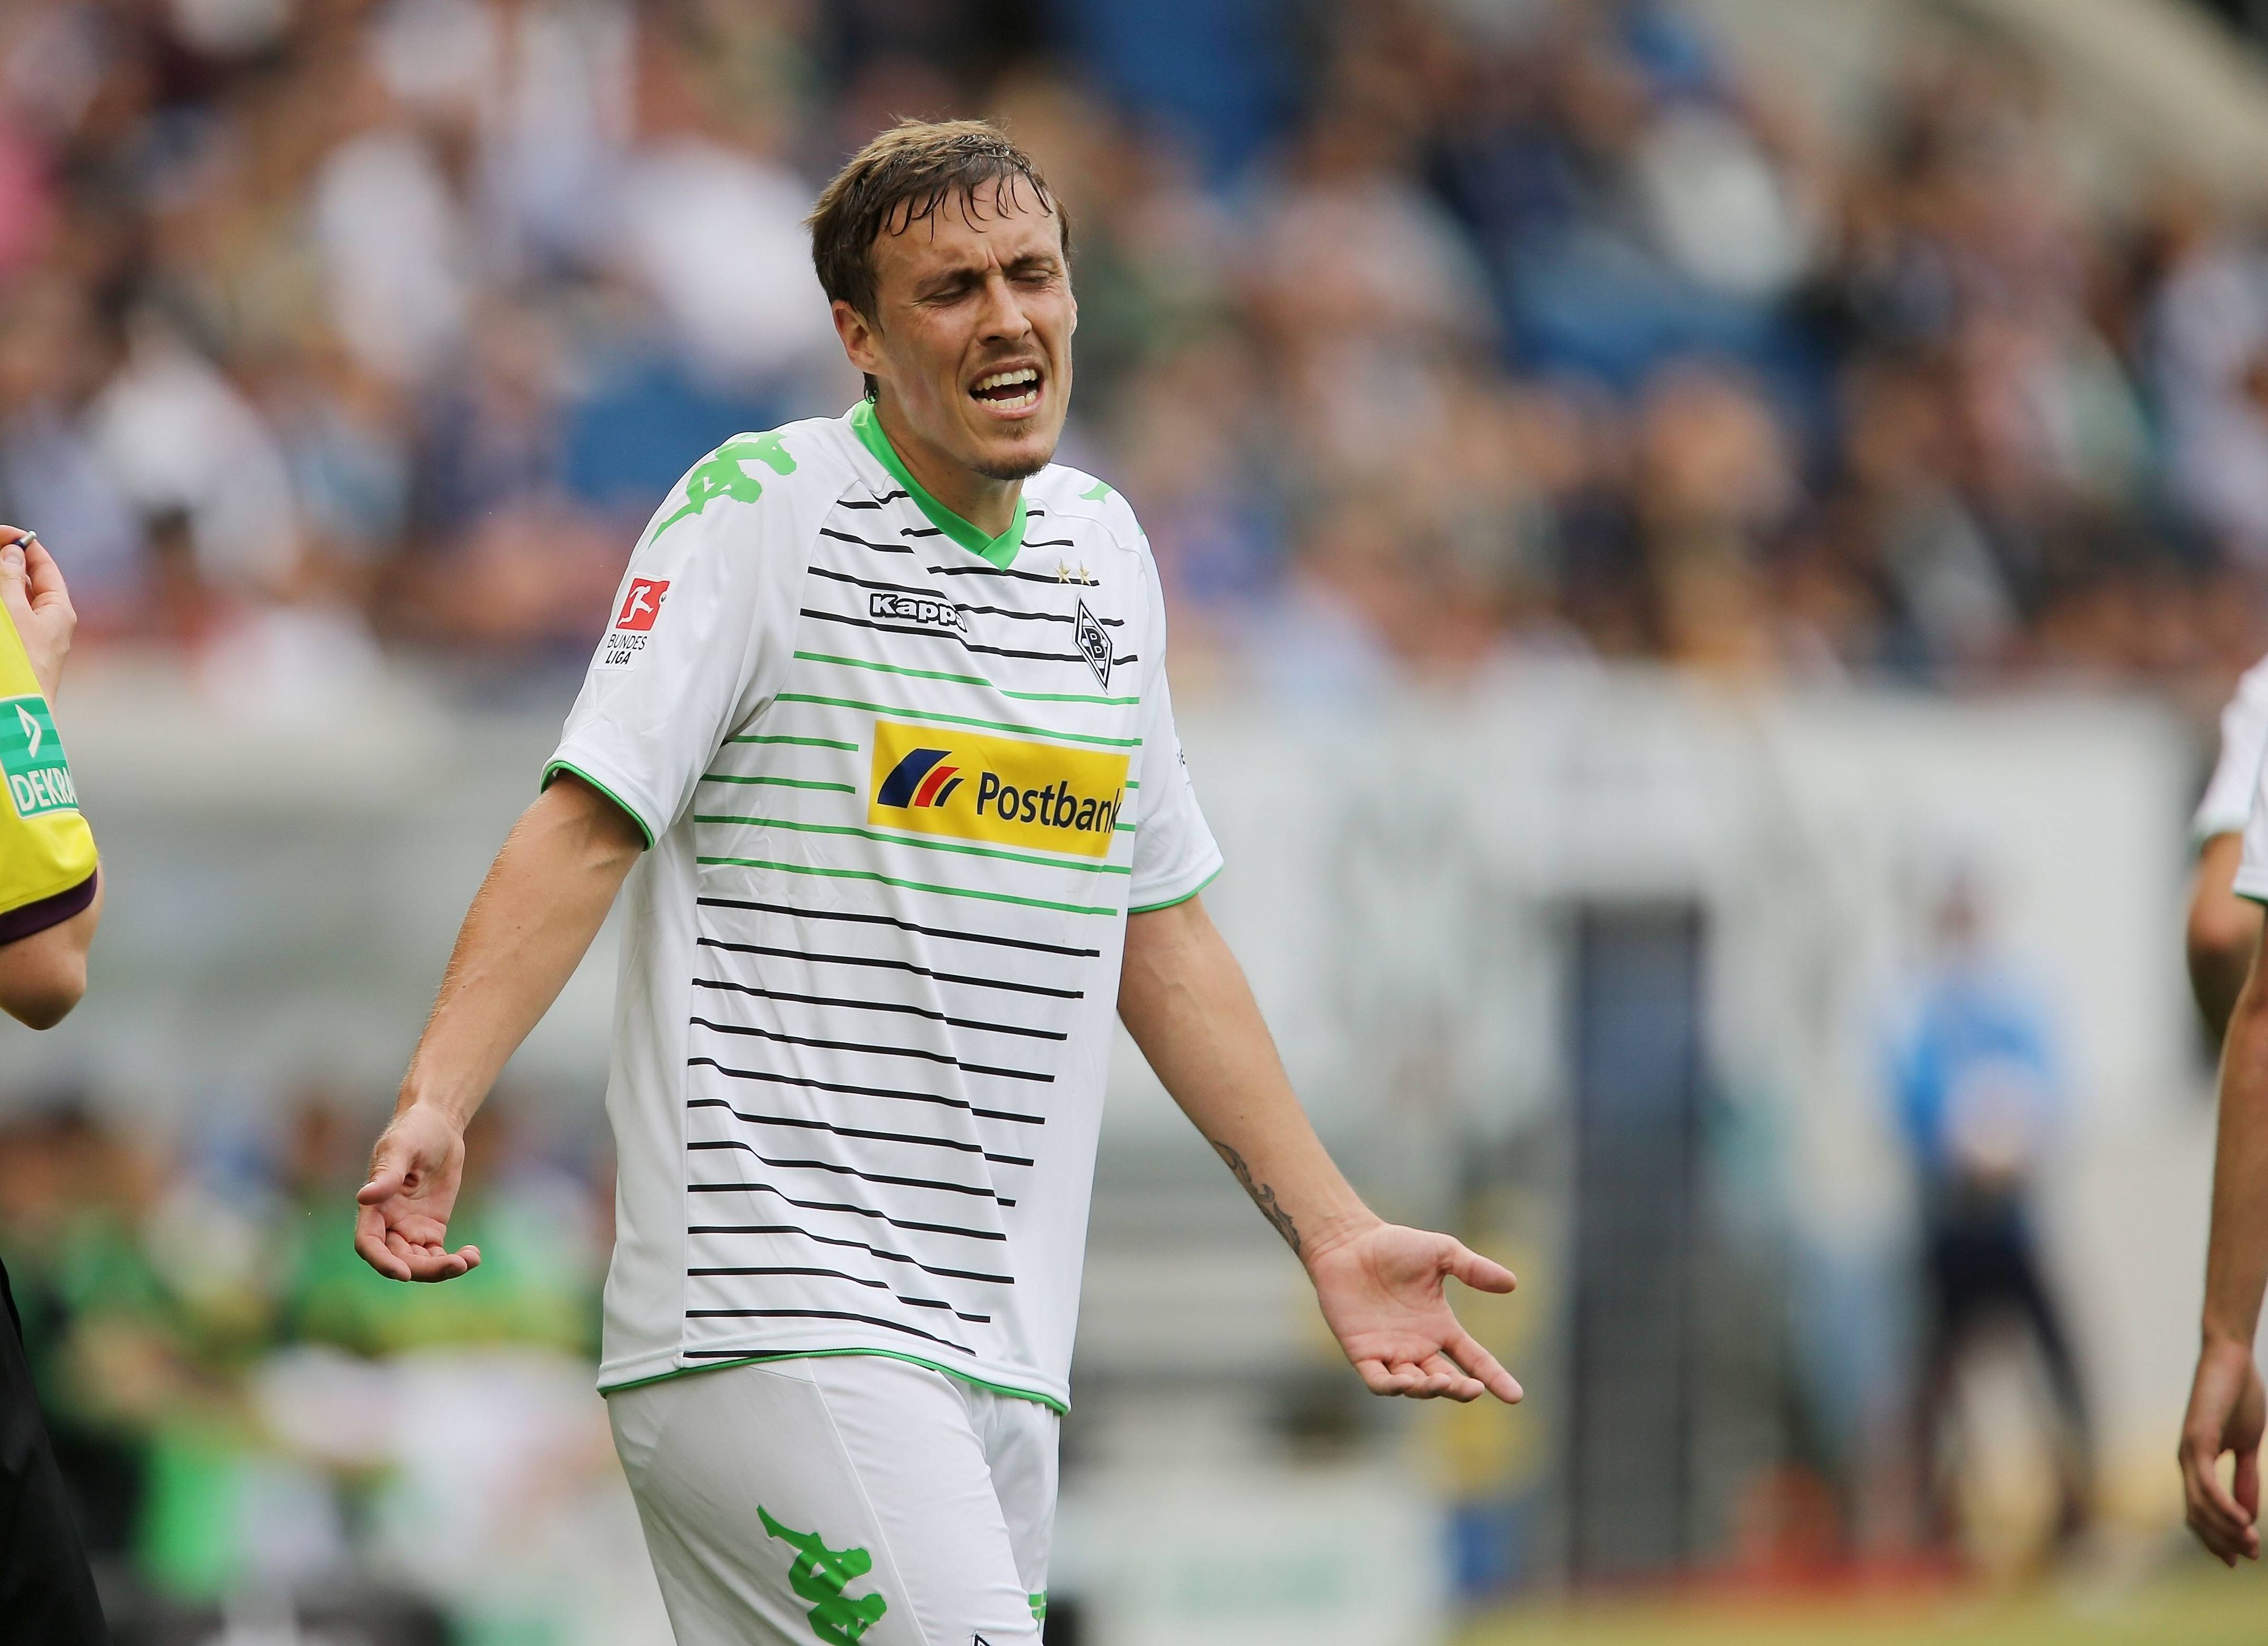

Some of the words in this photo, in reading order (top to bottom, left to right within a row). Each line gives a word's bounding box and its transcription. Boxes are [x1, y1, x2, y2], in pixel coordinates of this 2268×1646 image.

[870, 594, 967, 632] Kappa
[607, 634, 647, 650] BUNDES
[605, 651, 631, 665] LIGA
[977, 772, 1121, 833] Postbank
